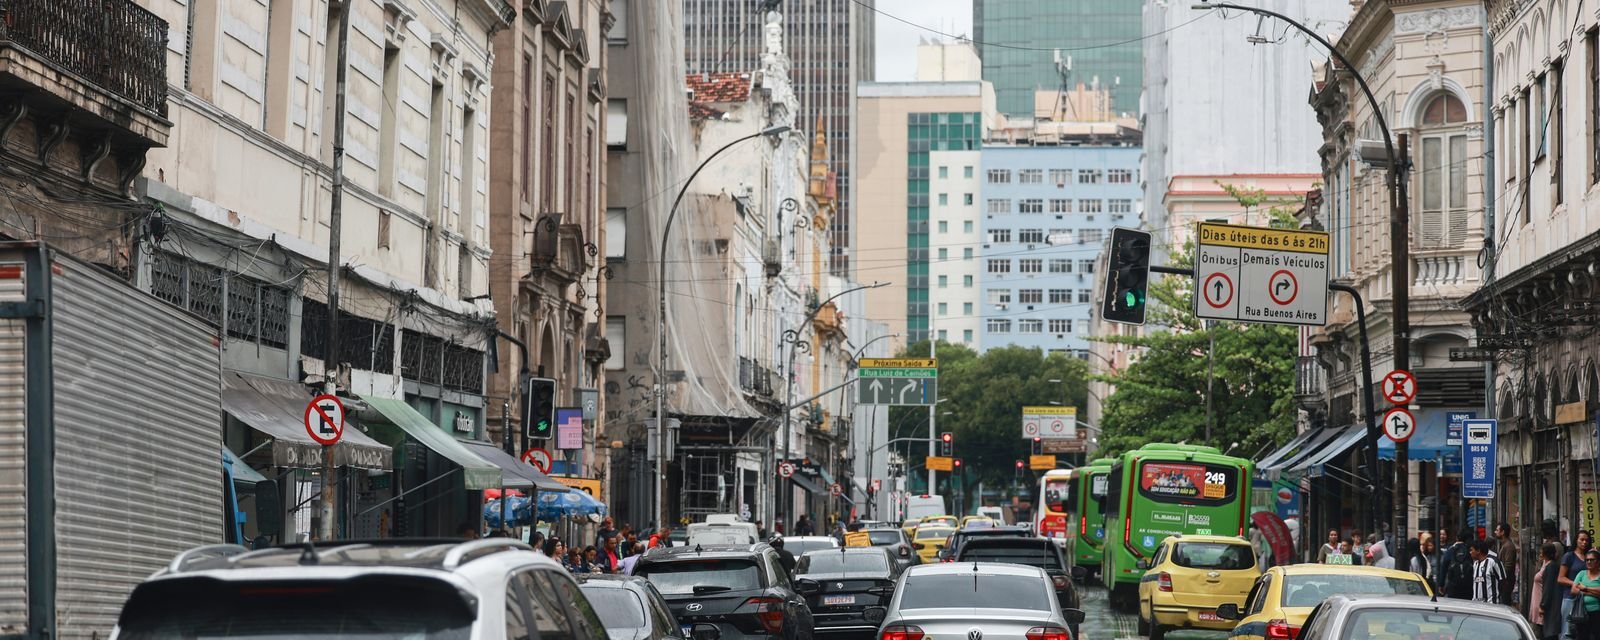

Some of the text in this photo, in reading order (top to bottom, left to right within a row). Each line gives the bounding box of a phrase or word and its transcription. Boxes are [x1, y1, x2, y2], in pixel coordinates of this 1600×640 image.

[1202, 229, 1226, 241] Dias
[1230, 230, 1257, 244] úteis
[1260, 234, 1279, 246] das
[1282, 235, 1290, 246] 6
[1308, 237, 1326, 249] 21h
[1201, 251, 1238, 265] Ônibus
[1243, 252, 1325, 269] Demais Veículos
[1245, 306, 1317, 320] Rua Buenos Aires
[864, 369, 878, 377] Rua
[894, 369, 901, 377] de
[1204, 471, 1226, 485] 249
[1196, 528, 1212, 536] TAXI
[1327, 554, 1353, 565] TAXI
